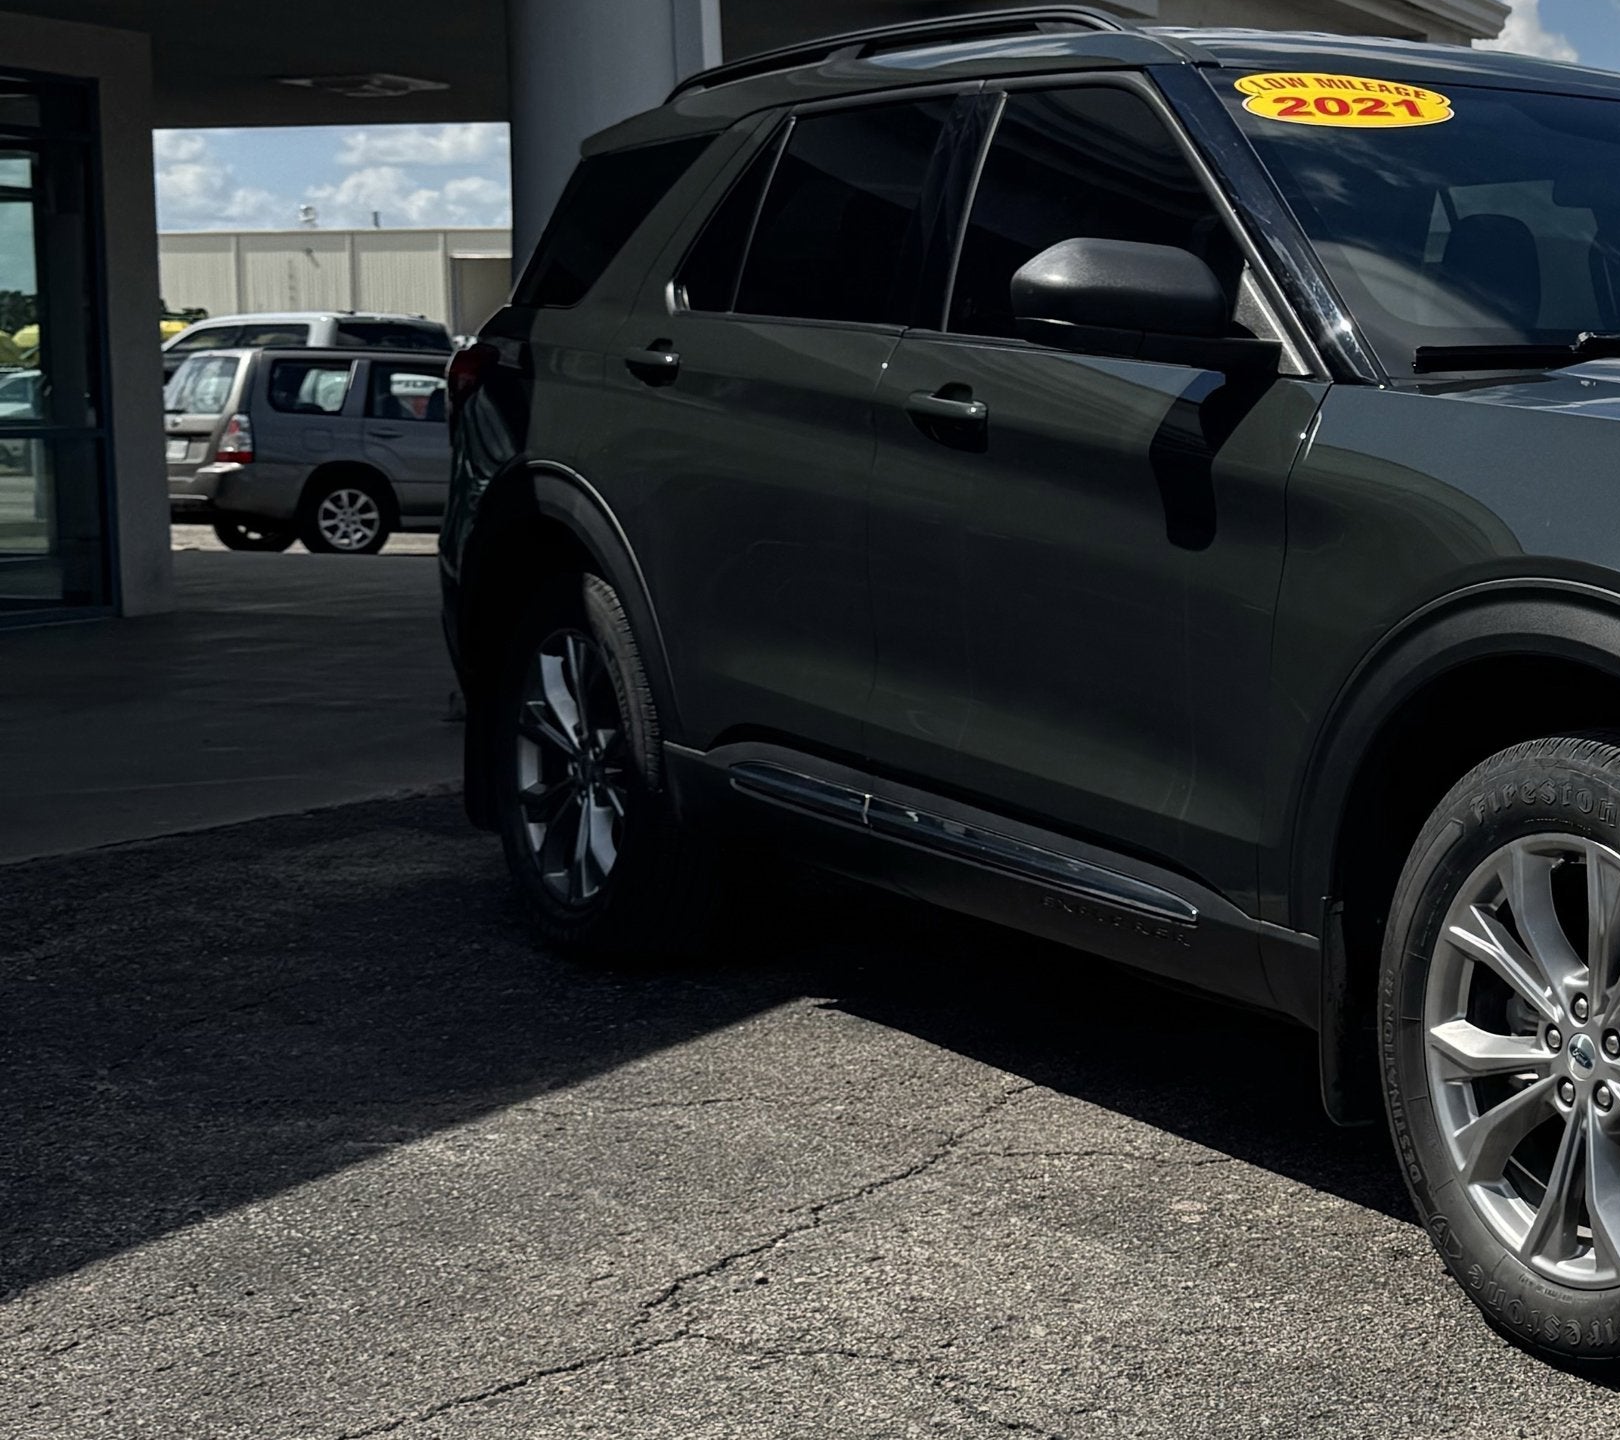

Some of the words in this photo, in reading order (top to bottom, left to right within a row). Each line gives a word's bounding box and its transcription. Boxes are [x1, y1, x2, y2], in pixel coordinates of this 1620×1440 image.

[1250, 77, 1309, 91] LOW
[1314, 77, 1428, 101] MILEAGE
[1272, 96, 1425, 118] 2021
